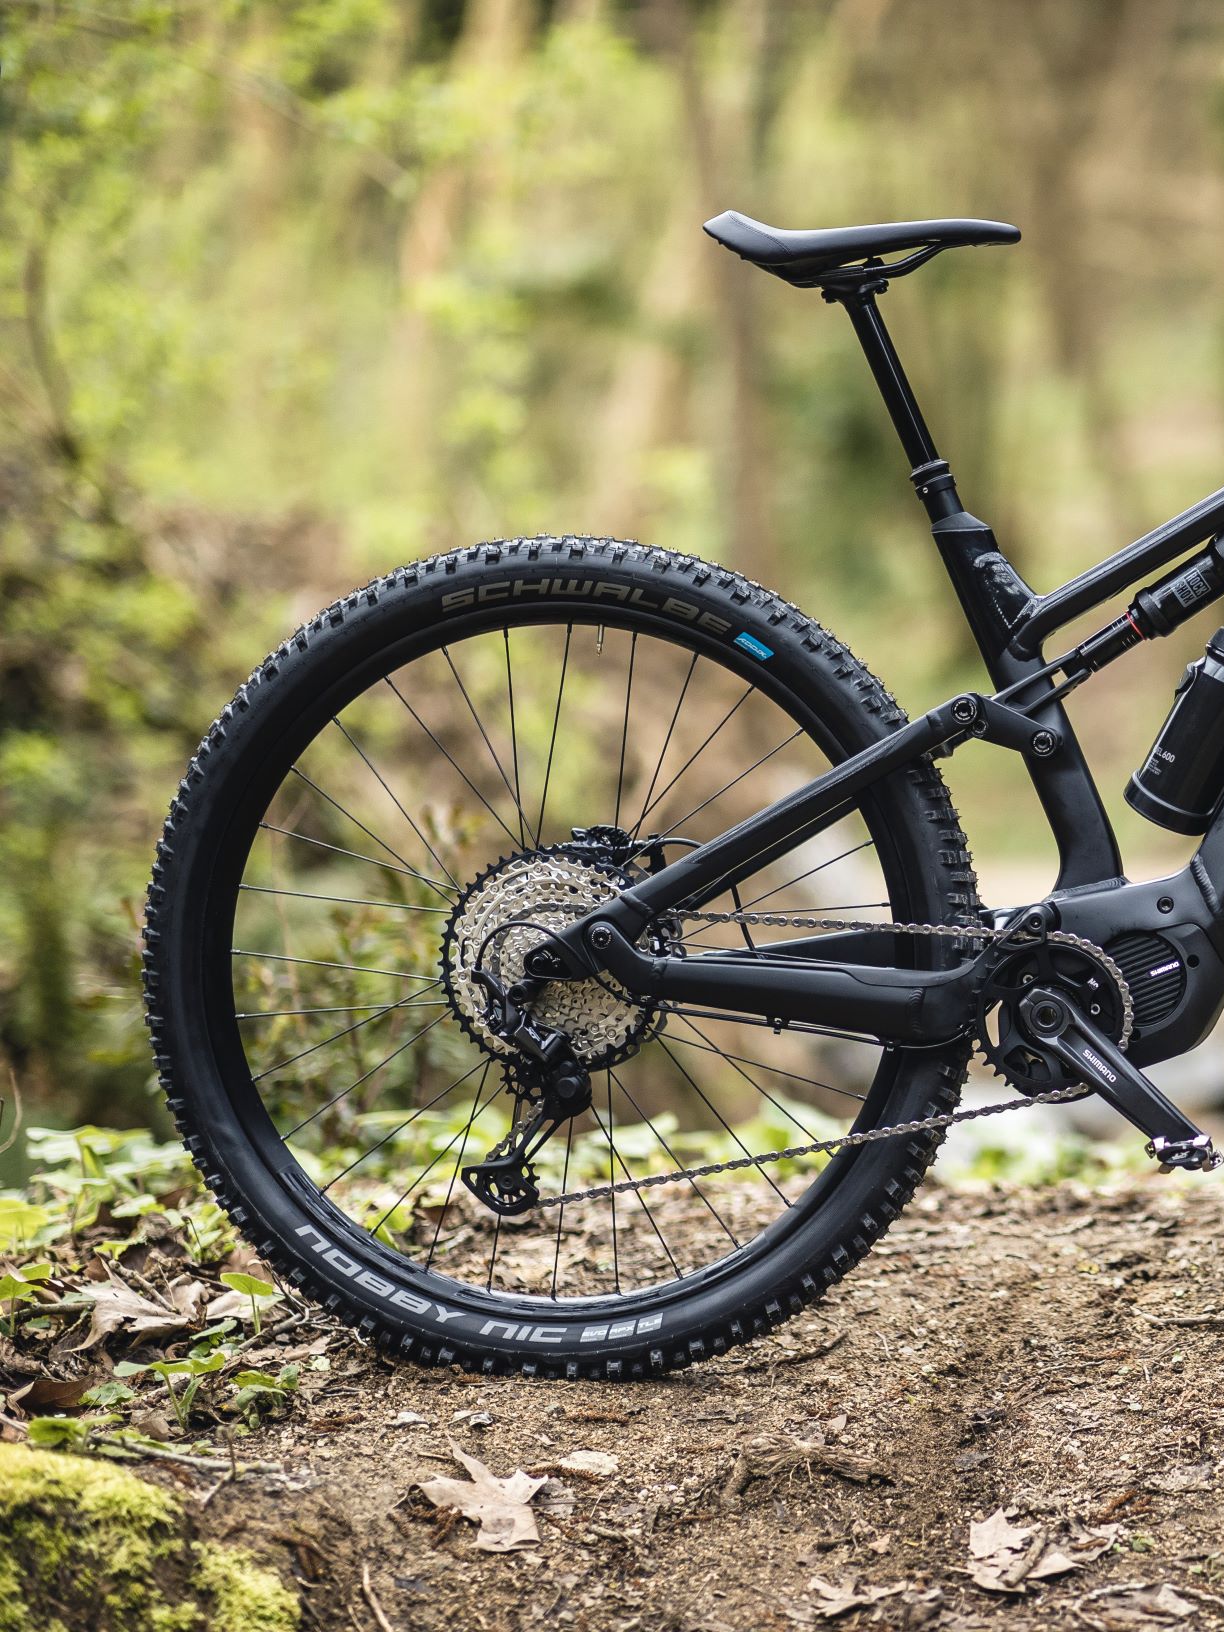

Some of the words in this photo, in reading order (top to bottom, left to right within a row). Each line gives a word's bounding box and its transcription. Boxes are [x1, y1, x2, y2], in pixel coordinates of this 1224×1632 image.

[1184, 569, 1209, 598] ROCK
[442, 577, 732, 635] SCHWALBE
[1150, 961, 1180, 977] SHIMANO
[1082, 1049, 1117, 1083] SHIMANO
[294, 1224, 467, 1324] NOBBY
[479, 1320, 567, 1344] NIC
